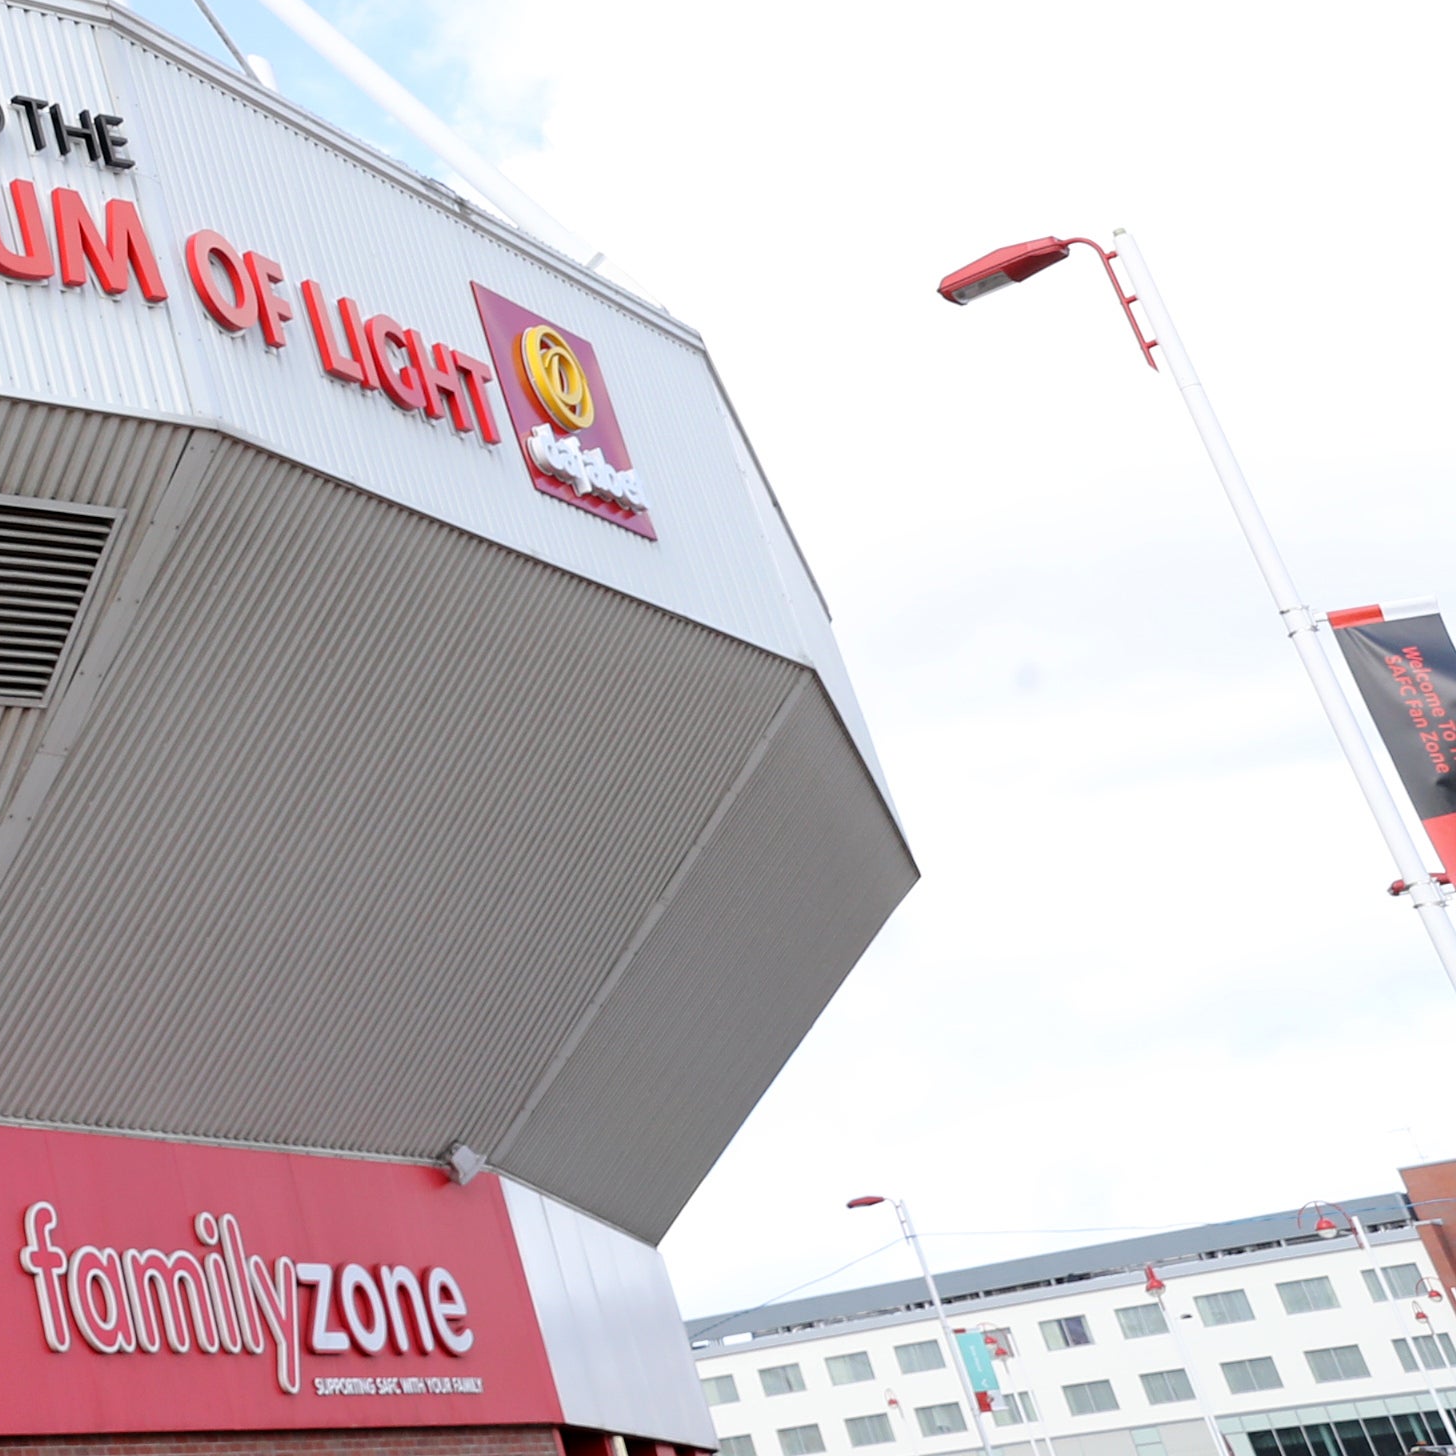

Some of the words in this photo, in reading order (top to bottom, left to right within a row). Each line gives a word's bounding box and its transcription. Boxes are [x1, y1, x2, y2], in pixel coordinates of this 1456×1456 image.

[10, 94, 135, 170] THE
[187, 228, 293, 348] OF
[300, 279, 501, 446] LIGHT
[1384, 655, 1417, 696] SAFC
[1405, 699, 1429, 728] Fan
[1419, 731, 1451, 774] Zone
[1401, 646, 1446, 717] Welcome
[1438, 719, 1456, 741] To
[314, 1377, 375, 1395] SUPPORTING
[400, 1377, 426, 1394] WITH
[425, 1377, 452, 1394] YOUR
[452, 1377, 484, 1394] FAMILY
